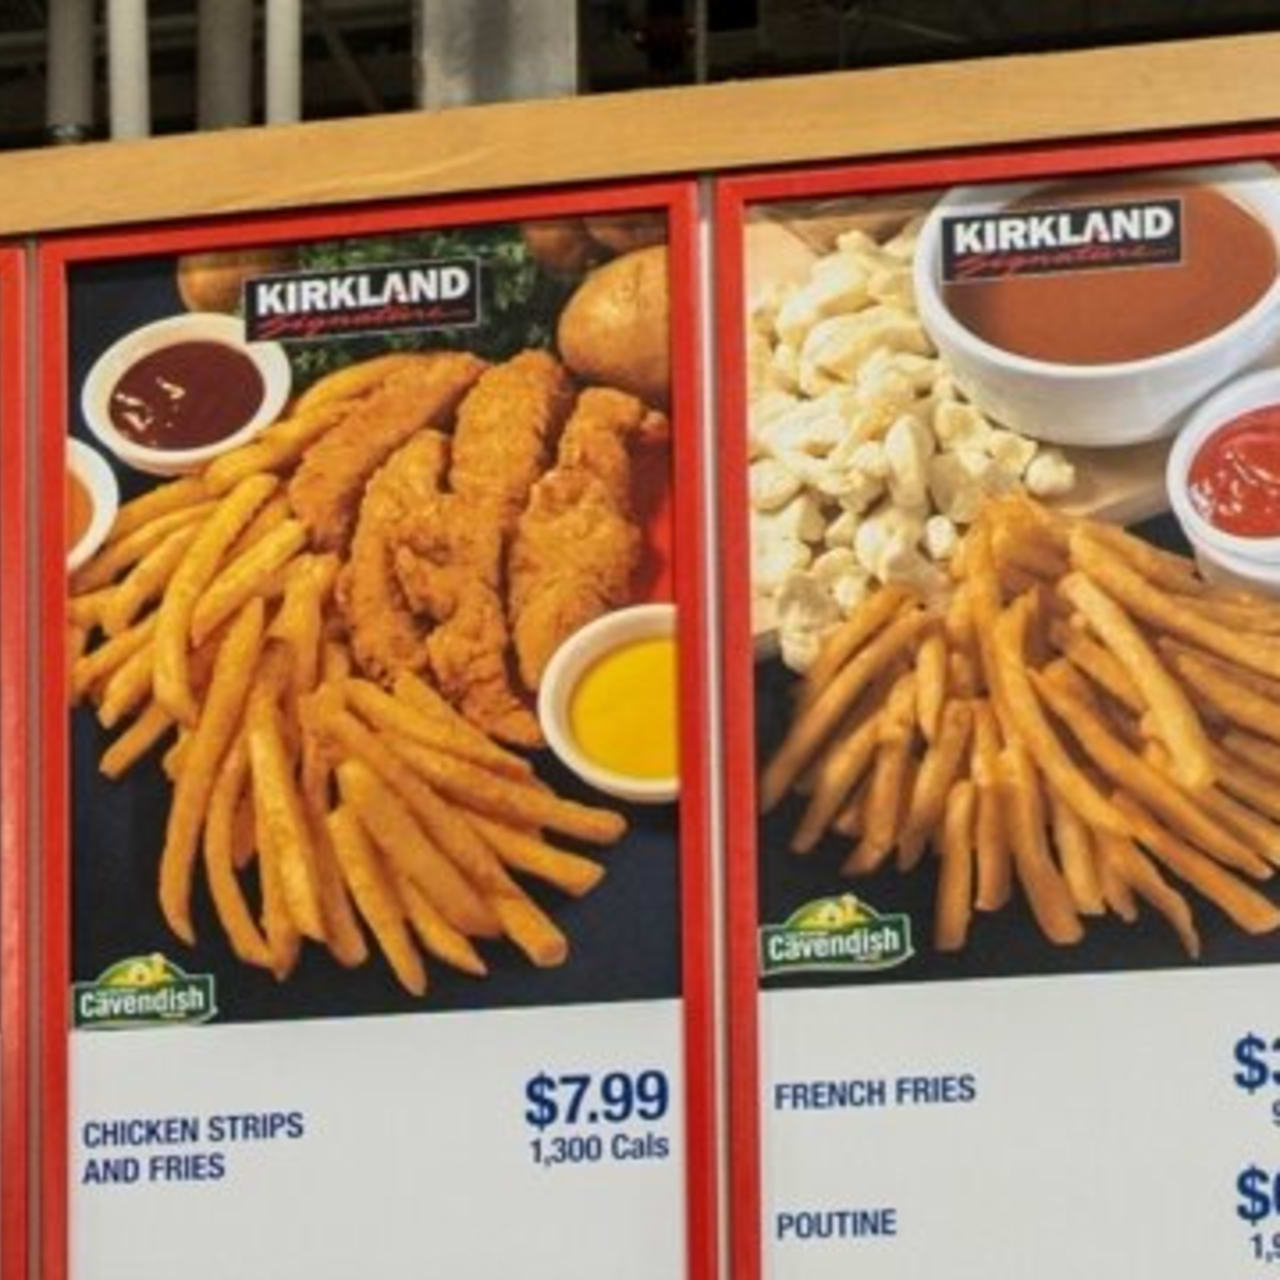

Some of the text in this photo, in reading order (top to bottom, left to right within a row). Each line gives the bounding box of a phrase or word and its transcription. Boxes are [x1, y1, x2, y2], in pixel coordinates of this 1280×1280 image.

[954, 206, 1174, 254] KIRKLAND
[256, 266, 470, 315] KIRKLAND
[769, 926, 900, 960] Cavendish
[80, 984, 204, 1017] Cavendish
[525, 1070, 669, 1131] $7.99
[775, 1074, 976, 1110] FRENCH FRIES
[83, 1112, 303, 1148] CHICKEN STRIPS
[530, 1132, 670, 1167] 1,300 Cals
[83, 1154, 225, 1184] AND FRIES
[777, 1209, 897, 1239] POUTINE
